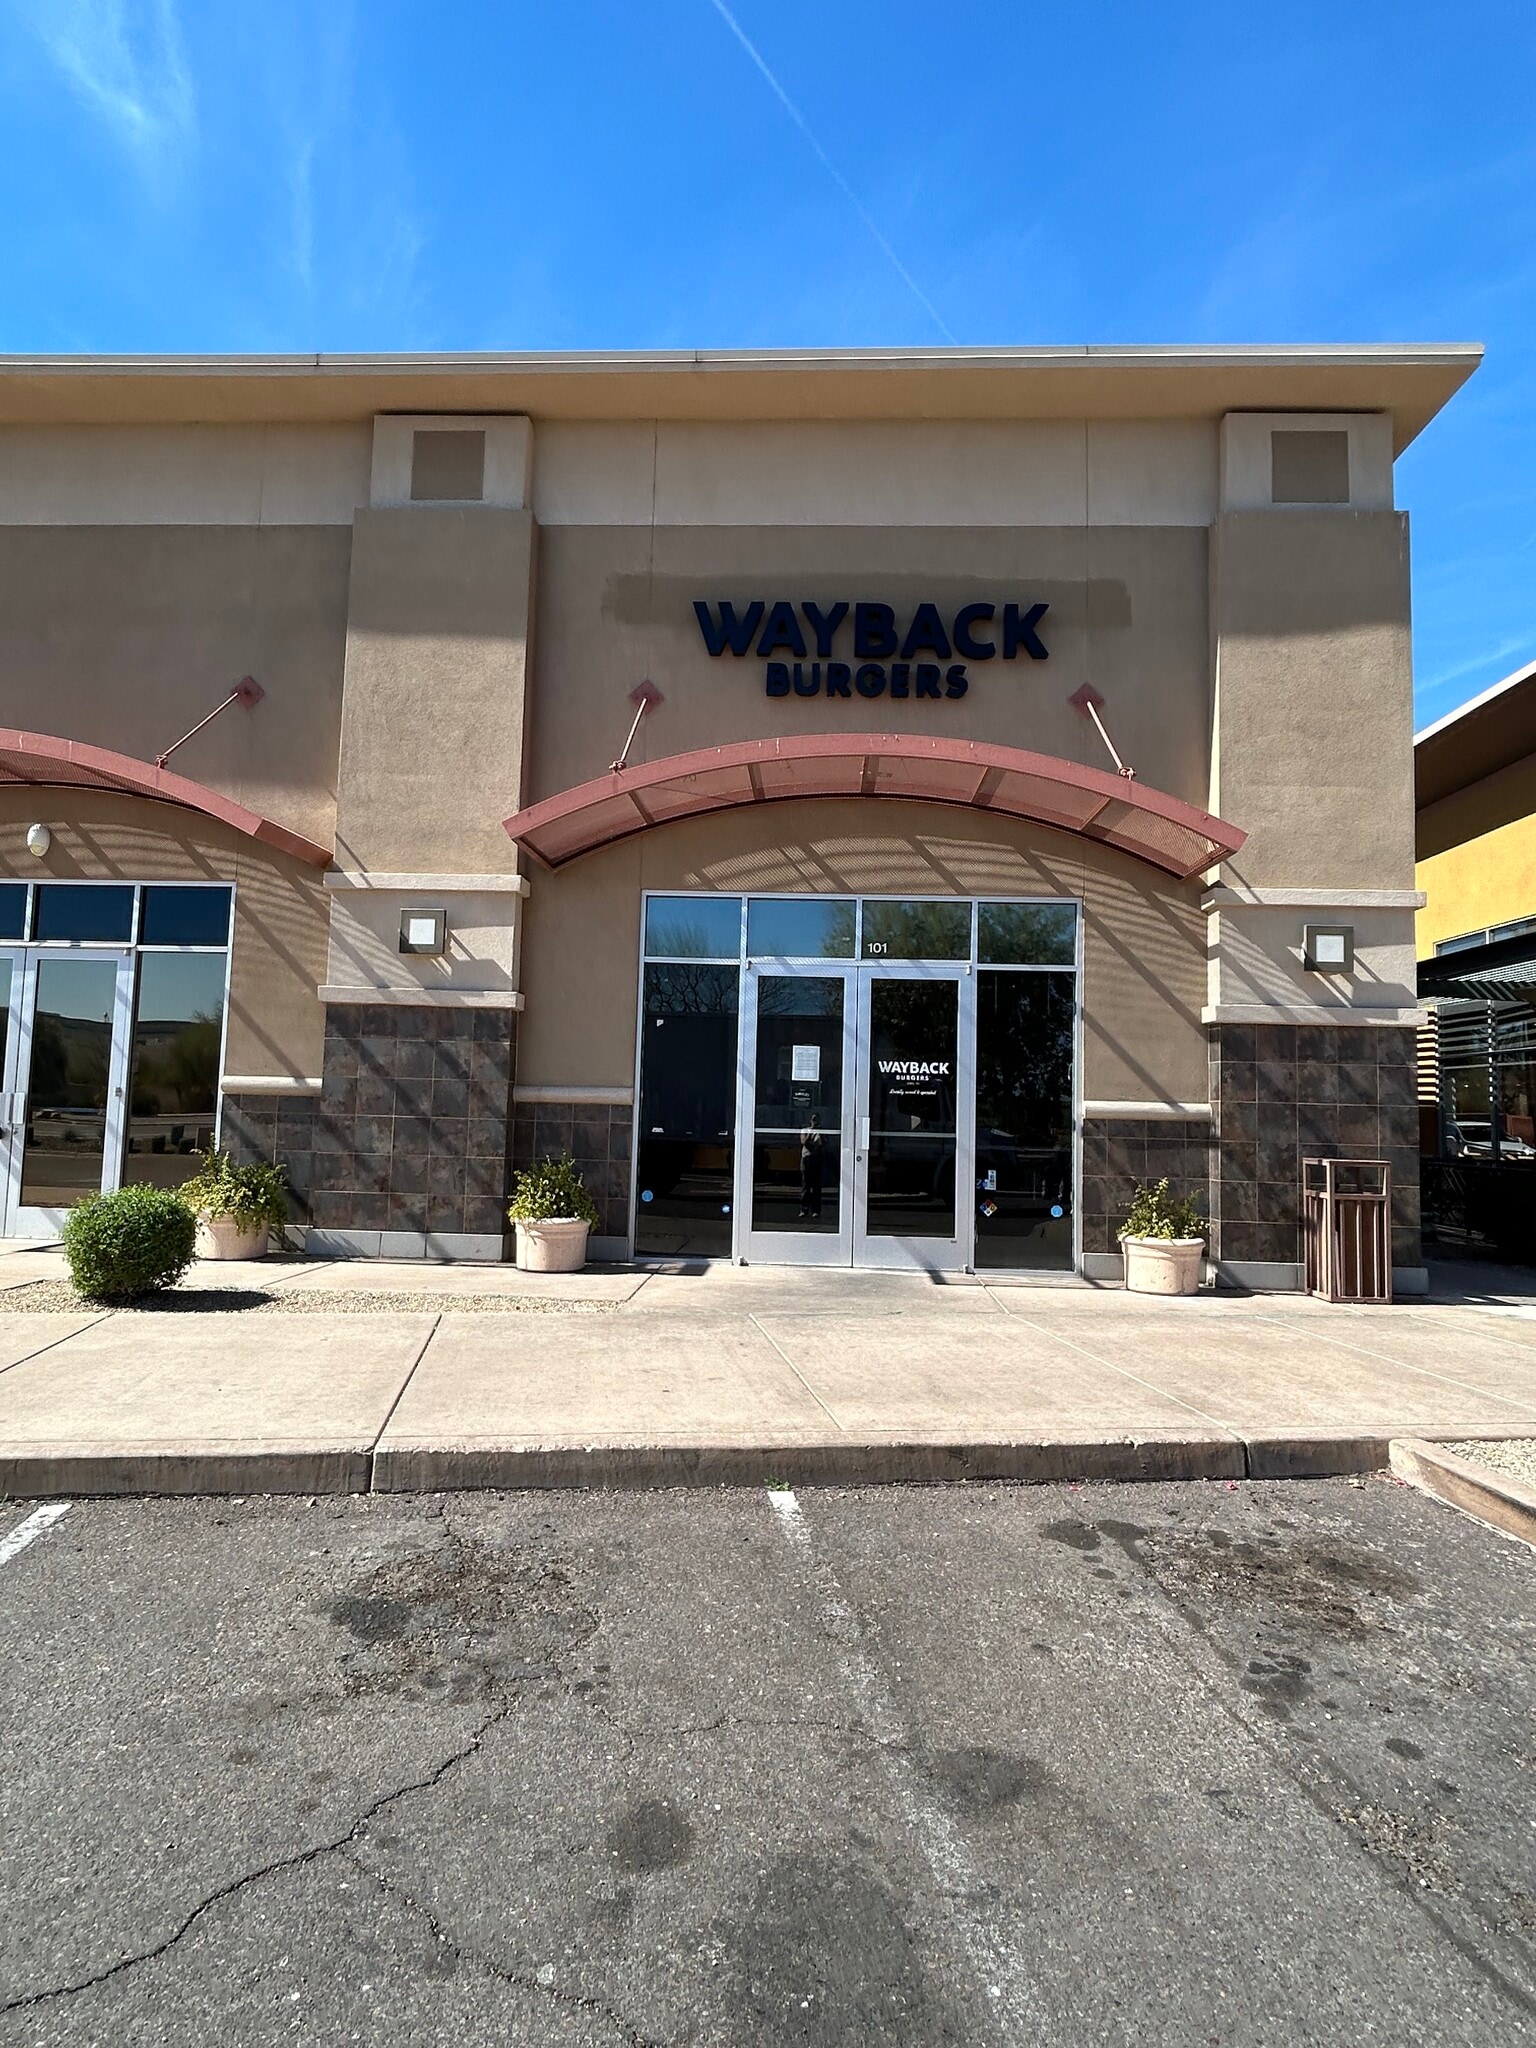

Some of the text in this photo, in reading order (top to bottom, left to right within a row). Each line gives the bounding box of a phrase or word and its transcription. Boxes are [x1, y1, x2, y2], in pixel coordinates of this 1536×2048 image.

[693, 600, 1049, 660] WAYBACK
[765, 661, 969, 699] BURGERS
[867, 942, 888, 954] 101
[878, 1061, 950, 1074] WAYBACK
